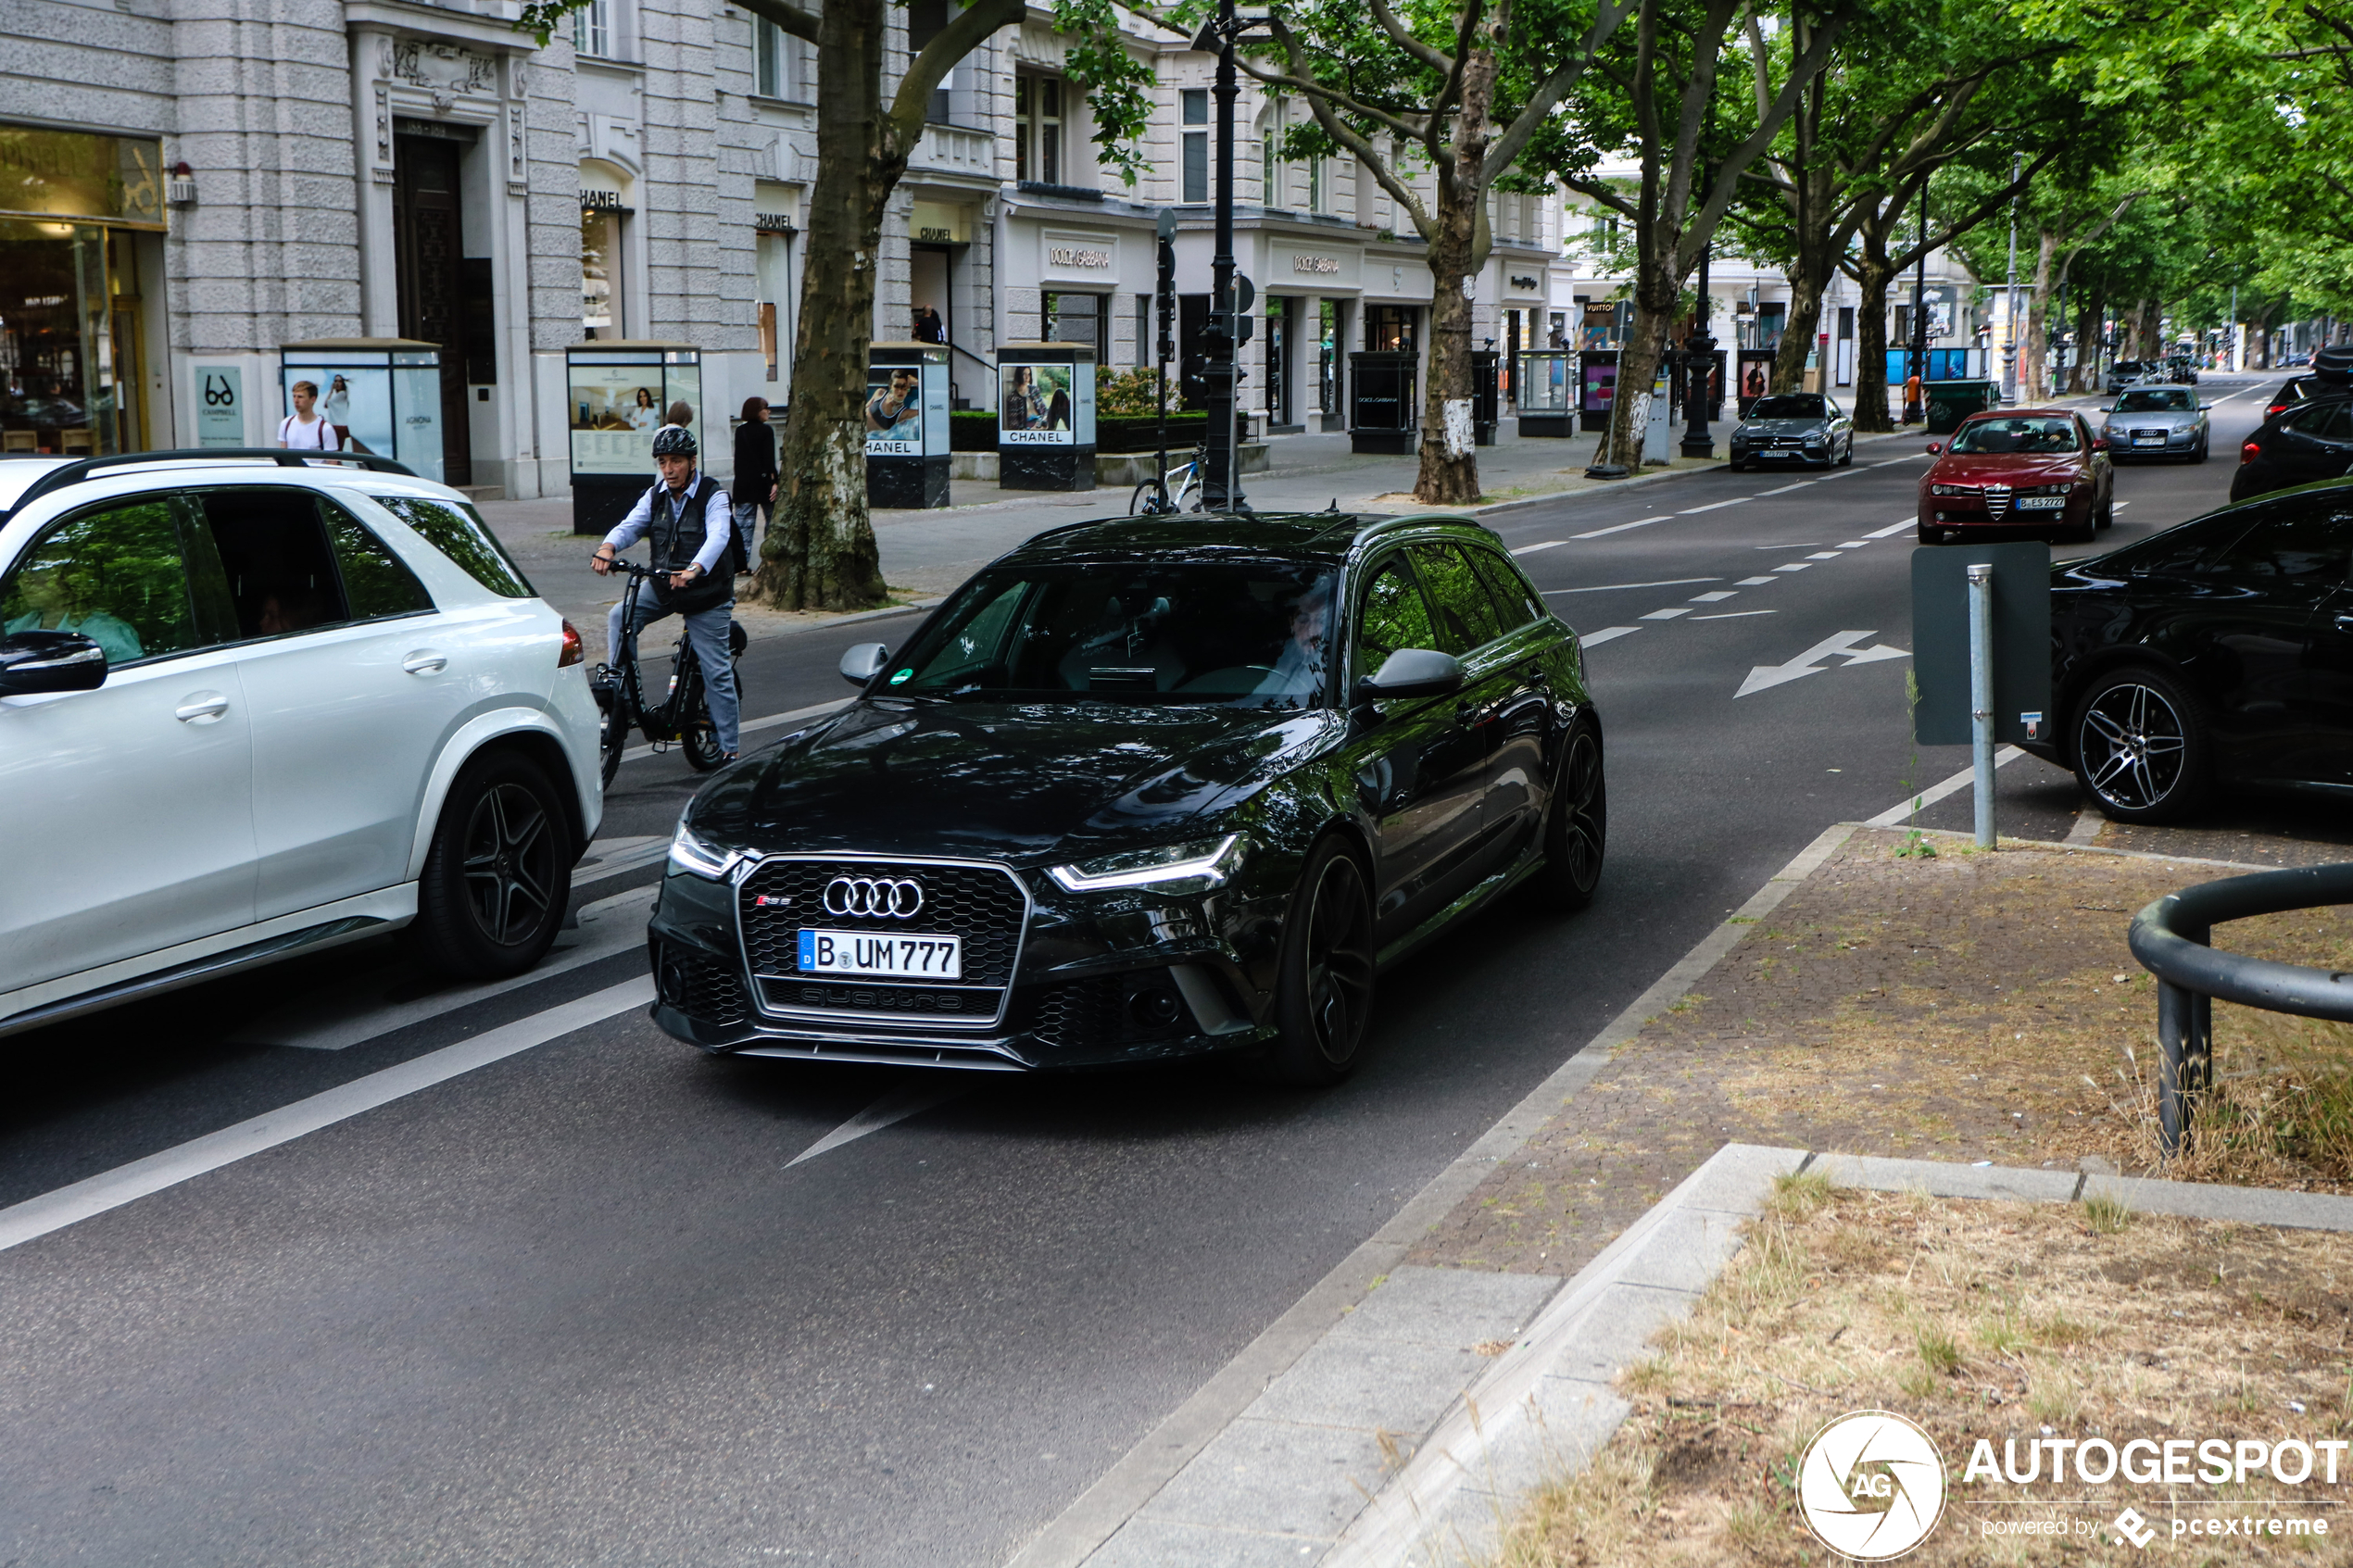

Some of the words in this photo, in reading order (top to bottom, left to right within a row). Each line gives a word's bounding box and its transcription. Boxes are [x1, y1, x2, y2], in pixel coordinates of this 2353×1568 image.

[580, 189, 623, 207] HANEL
[920, 227, 952, 241] CHANEL
[1009, 432, 1063, 443] CHANEL
[865, 442, 912, 453] HANEL
[2020, 499, 2027, 508] B
[803, 955, 812, 964] D
[818, 936, 835, 967] B
[856, 938, 893, 970] UM
[900, 941, 955, 972] 777
[801, 987, 963, 1010] quattro
